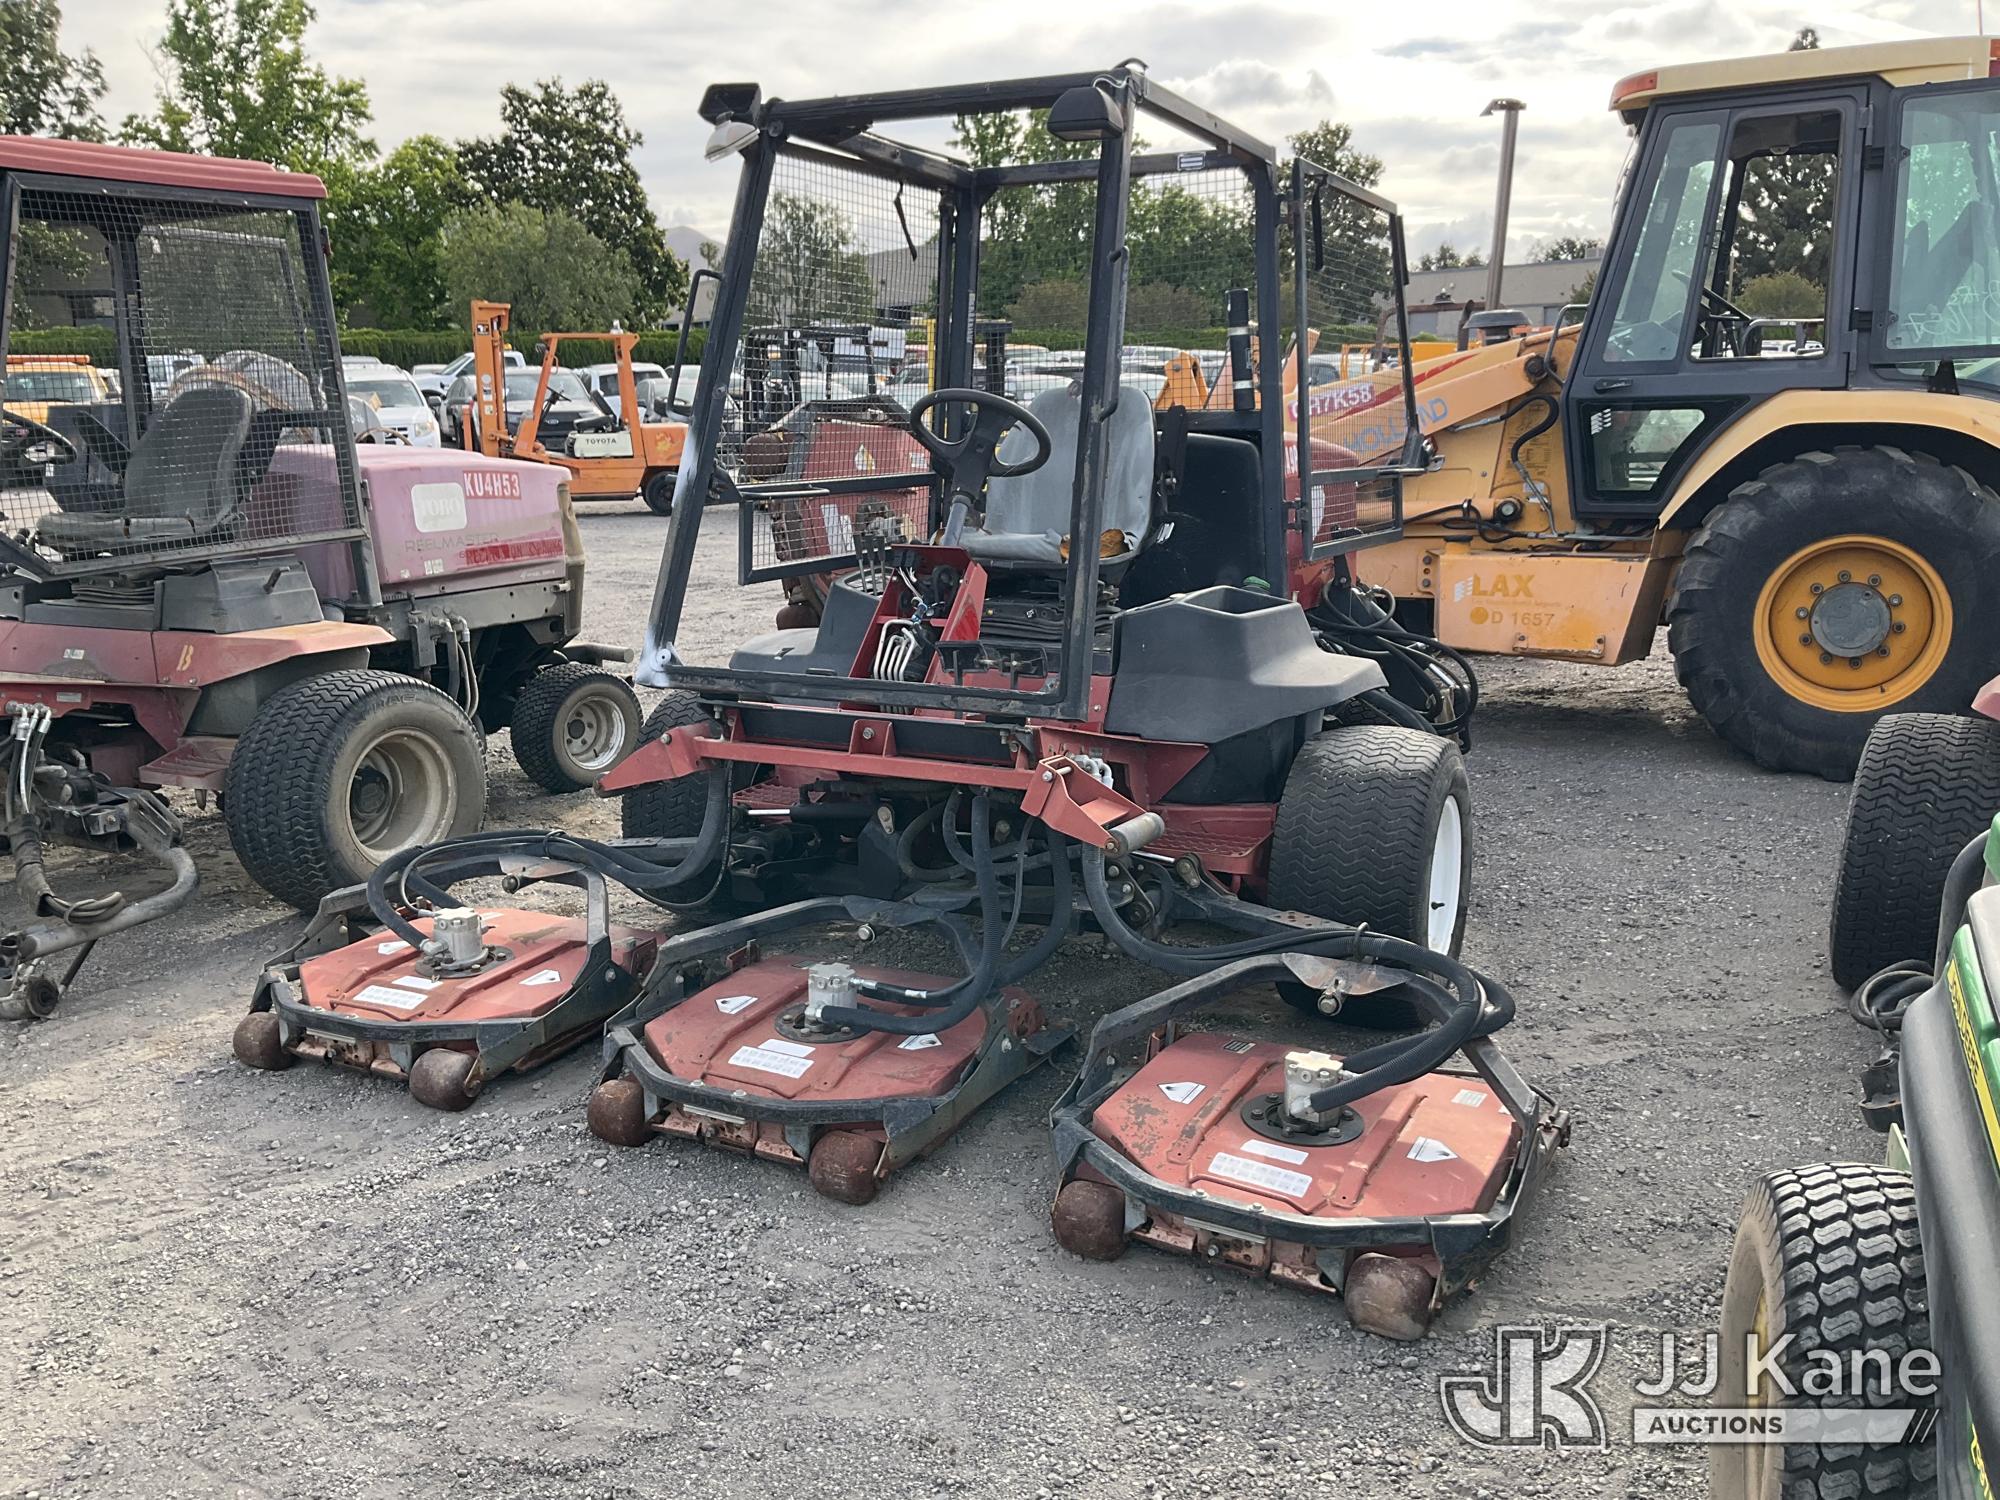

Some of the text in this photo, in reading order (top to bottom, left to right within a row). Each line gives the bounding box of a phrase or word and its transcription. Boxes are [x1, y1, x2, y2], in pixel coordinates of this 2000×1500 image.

[464, 471, 520, 497] KU4H53
[405, 532, 499, 552] REELMASTER
[1472, 574, 1535, 598] LAX
[1491, 611, 1555, 627] D 1657
